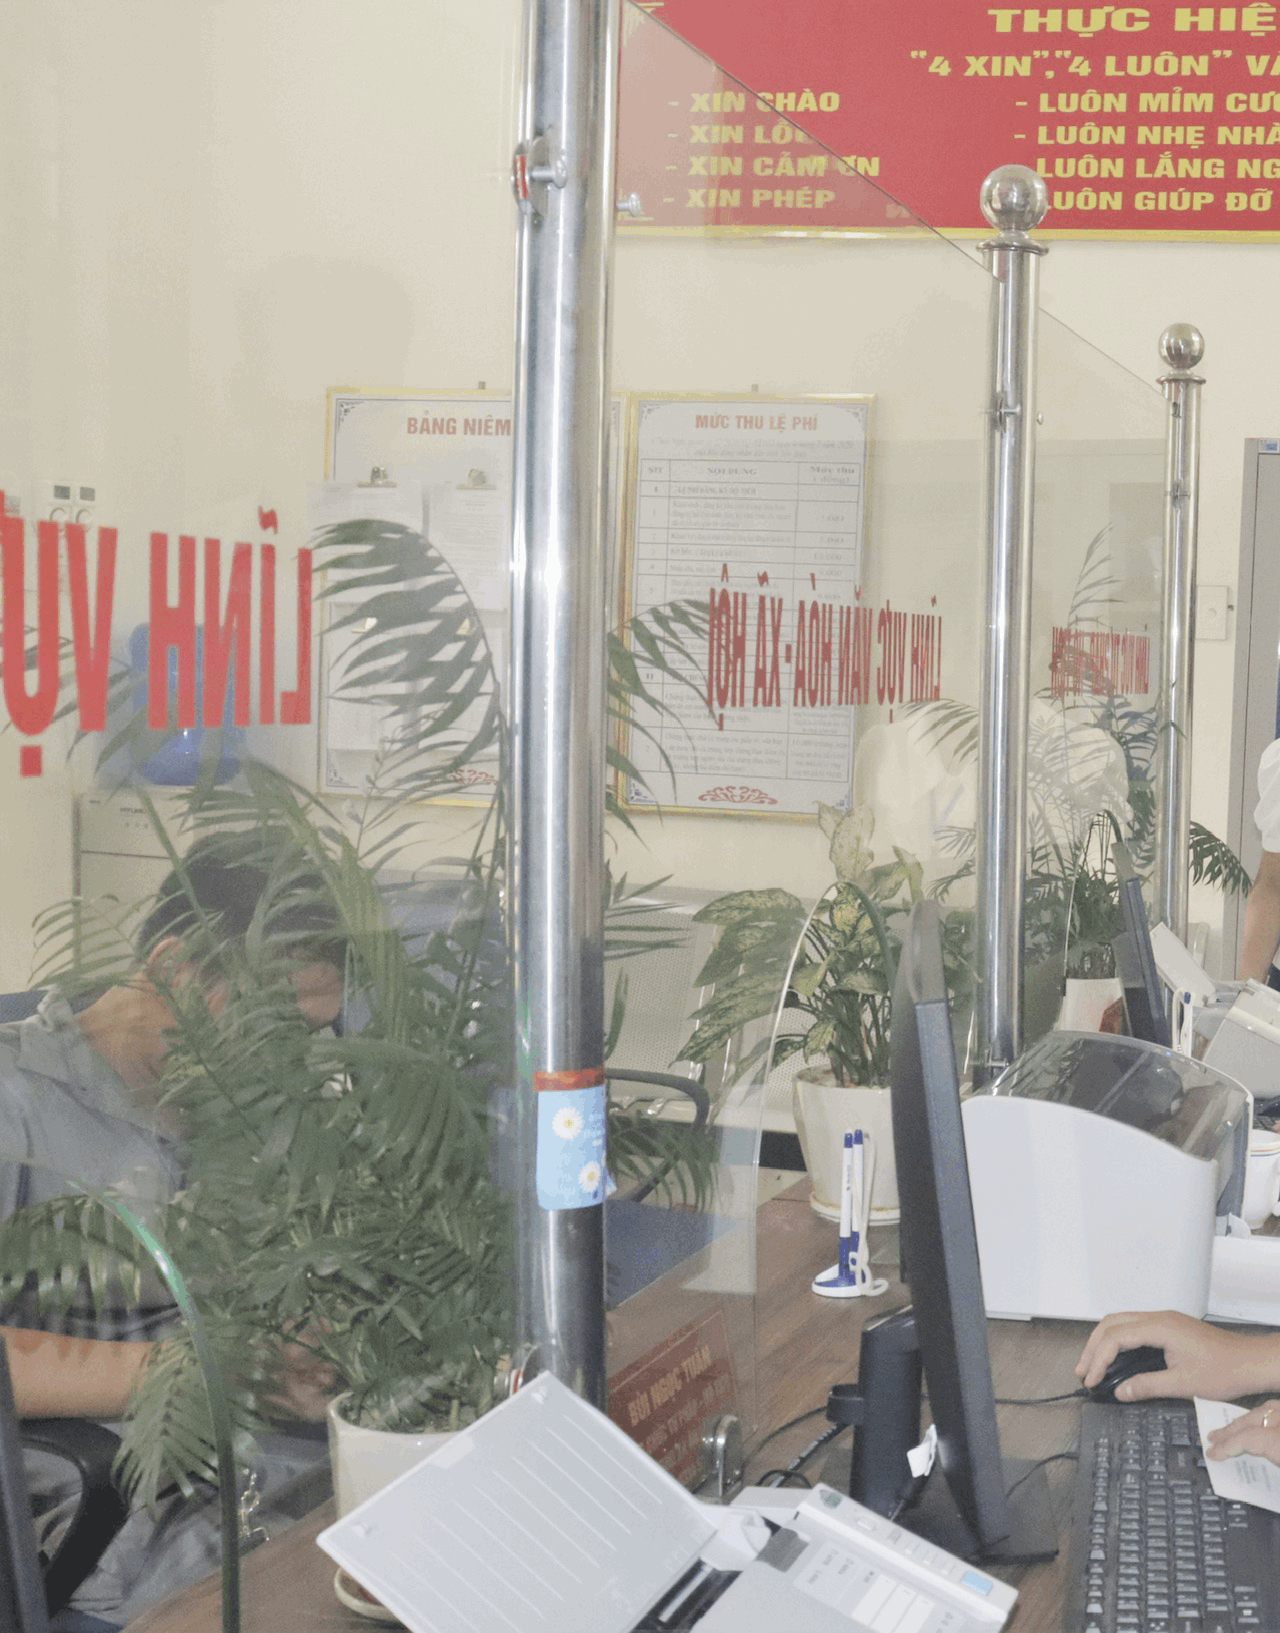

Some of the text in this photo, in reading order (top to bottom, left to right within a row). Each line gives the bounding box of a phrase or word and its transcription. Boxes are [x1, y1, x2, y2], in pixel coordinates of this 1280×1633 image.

[988, 5, 1150, 38] THỰC
[690, 88, 840, 113] XIN CHÀO
[1039, 89, 1127, 113] LUÔN
[1139, 86, 1213, 113] MỈM
[689, 125, 744, 144] XIN
[1037, 122, 1125, 145] LUÔN
[1137, 126, 1205, 149] NHẸ
[687, 155, 743, 176] XIN
[753, 151, 827, 177] CẢM
[1036, 154, 1124, 178] LUÔN
[1136, 151, 1225, 179] LẮNG
[685, 186, 836, 209] XIN PHÉP
[1047, 187, 1274, 211] UÔN GIÚP ĐỠ
[407, 410, 511, 436] BẢNG NIÊM
[695, 412, 819, 433] MỨC THU LỆ PHÍ
